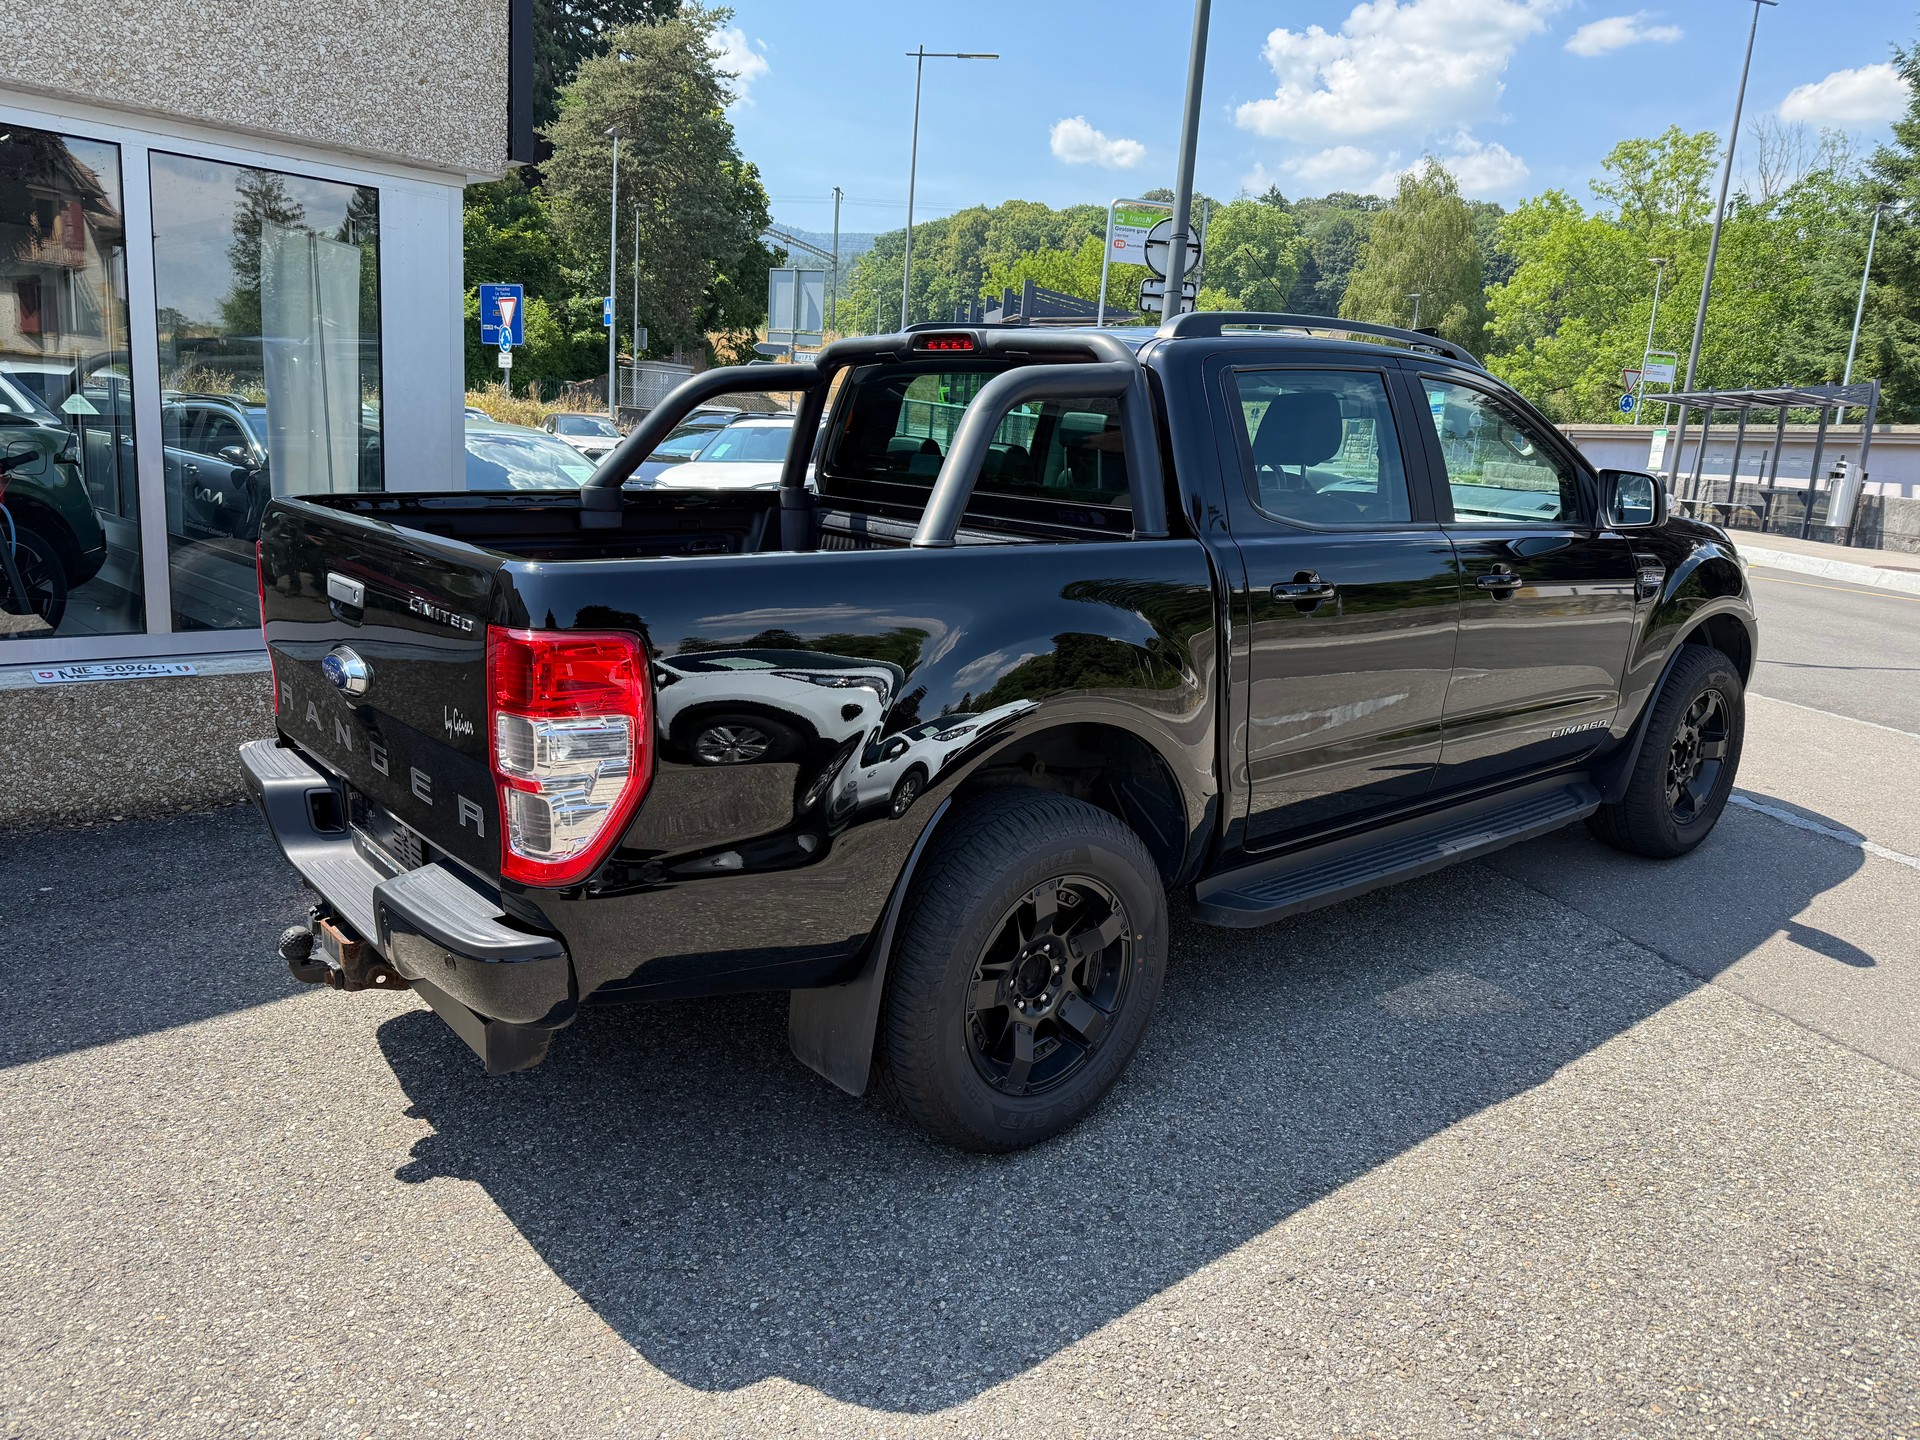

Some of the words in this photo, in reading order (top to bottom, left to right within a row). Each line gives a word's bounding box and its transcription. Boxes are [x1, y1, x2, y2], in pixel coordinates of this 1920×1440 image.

[1129, 215, 1152, 223] transN
[194, 487, 223, 505] KIA
[410, 597, 474, 632] LIMITED
[71, 666, 95, 675] NE
[104, 664, 158, 672] 50964
[1551, 719, 1607, 738] LIMITED
[281, 682, 485, 838] RANGER
[956, 848, 1077, 987] YOKOHAMA
[1064, 936, 1158, 1117] GEOLANDAR
